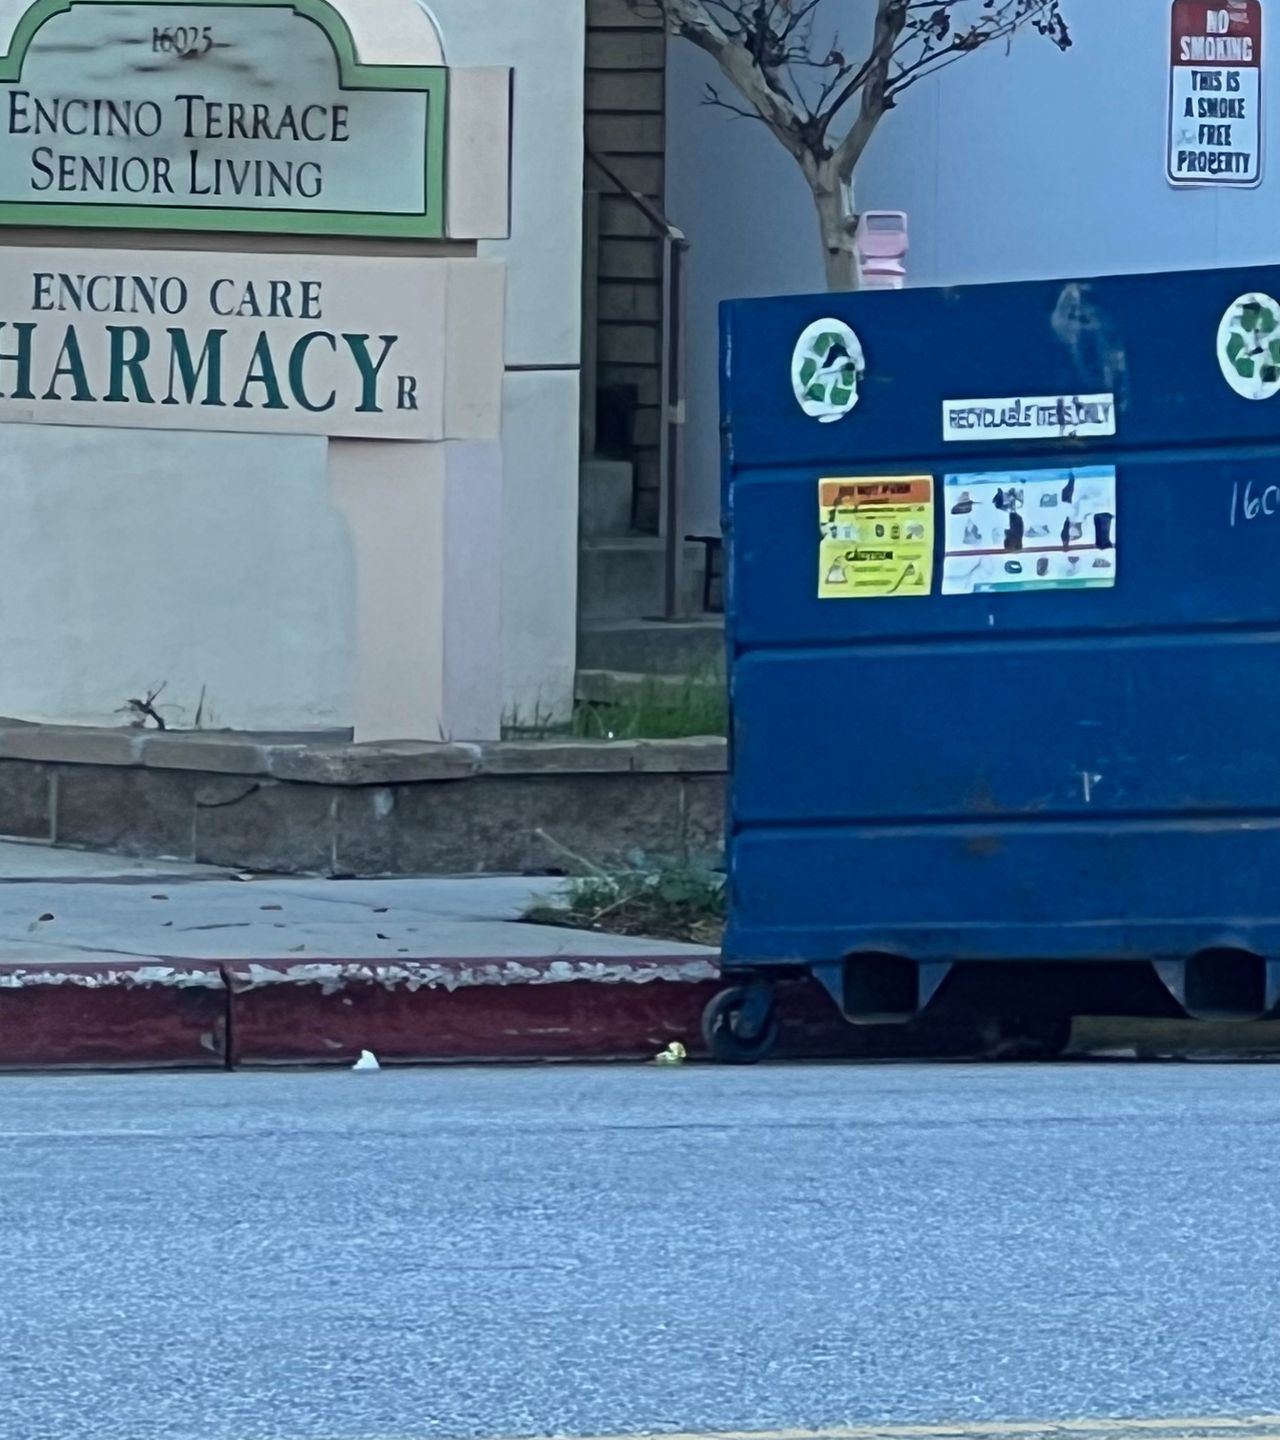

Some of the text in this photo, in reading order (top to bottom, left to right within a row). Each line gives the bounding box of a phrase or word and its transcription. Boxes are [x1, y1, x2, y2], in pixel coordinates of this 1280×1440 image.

[1206, 9, 1230, 34] NO
[1180, 36, 1253, 62] SMOKING
[1190, 70, 1241, 92] THIS IS
[8, 89, 351, 143] ENCINO TERRACE
[1183, 96, 1246, 120] A SMOKE
[1197, 123, 1232, 147] FREE
[30, 146, 324, 198] SENIOR LIVING
[1176, 150, 1251, 174] PROPERTY
[31, 272, 323, 320] ENCINO CARE
